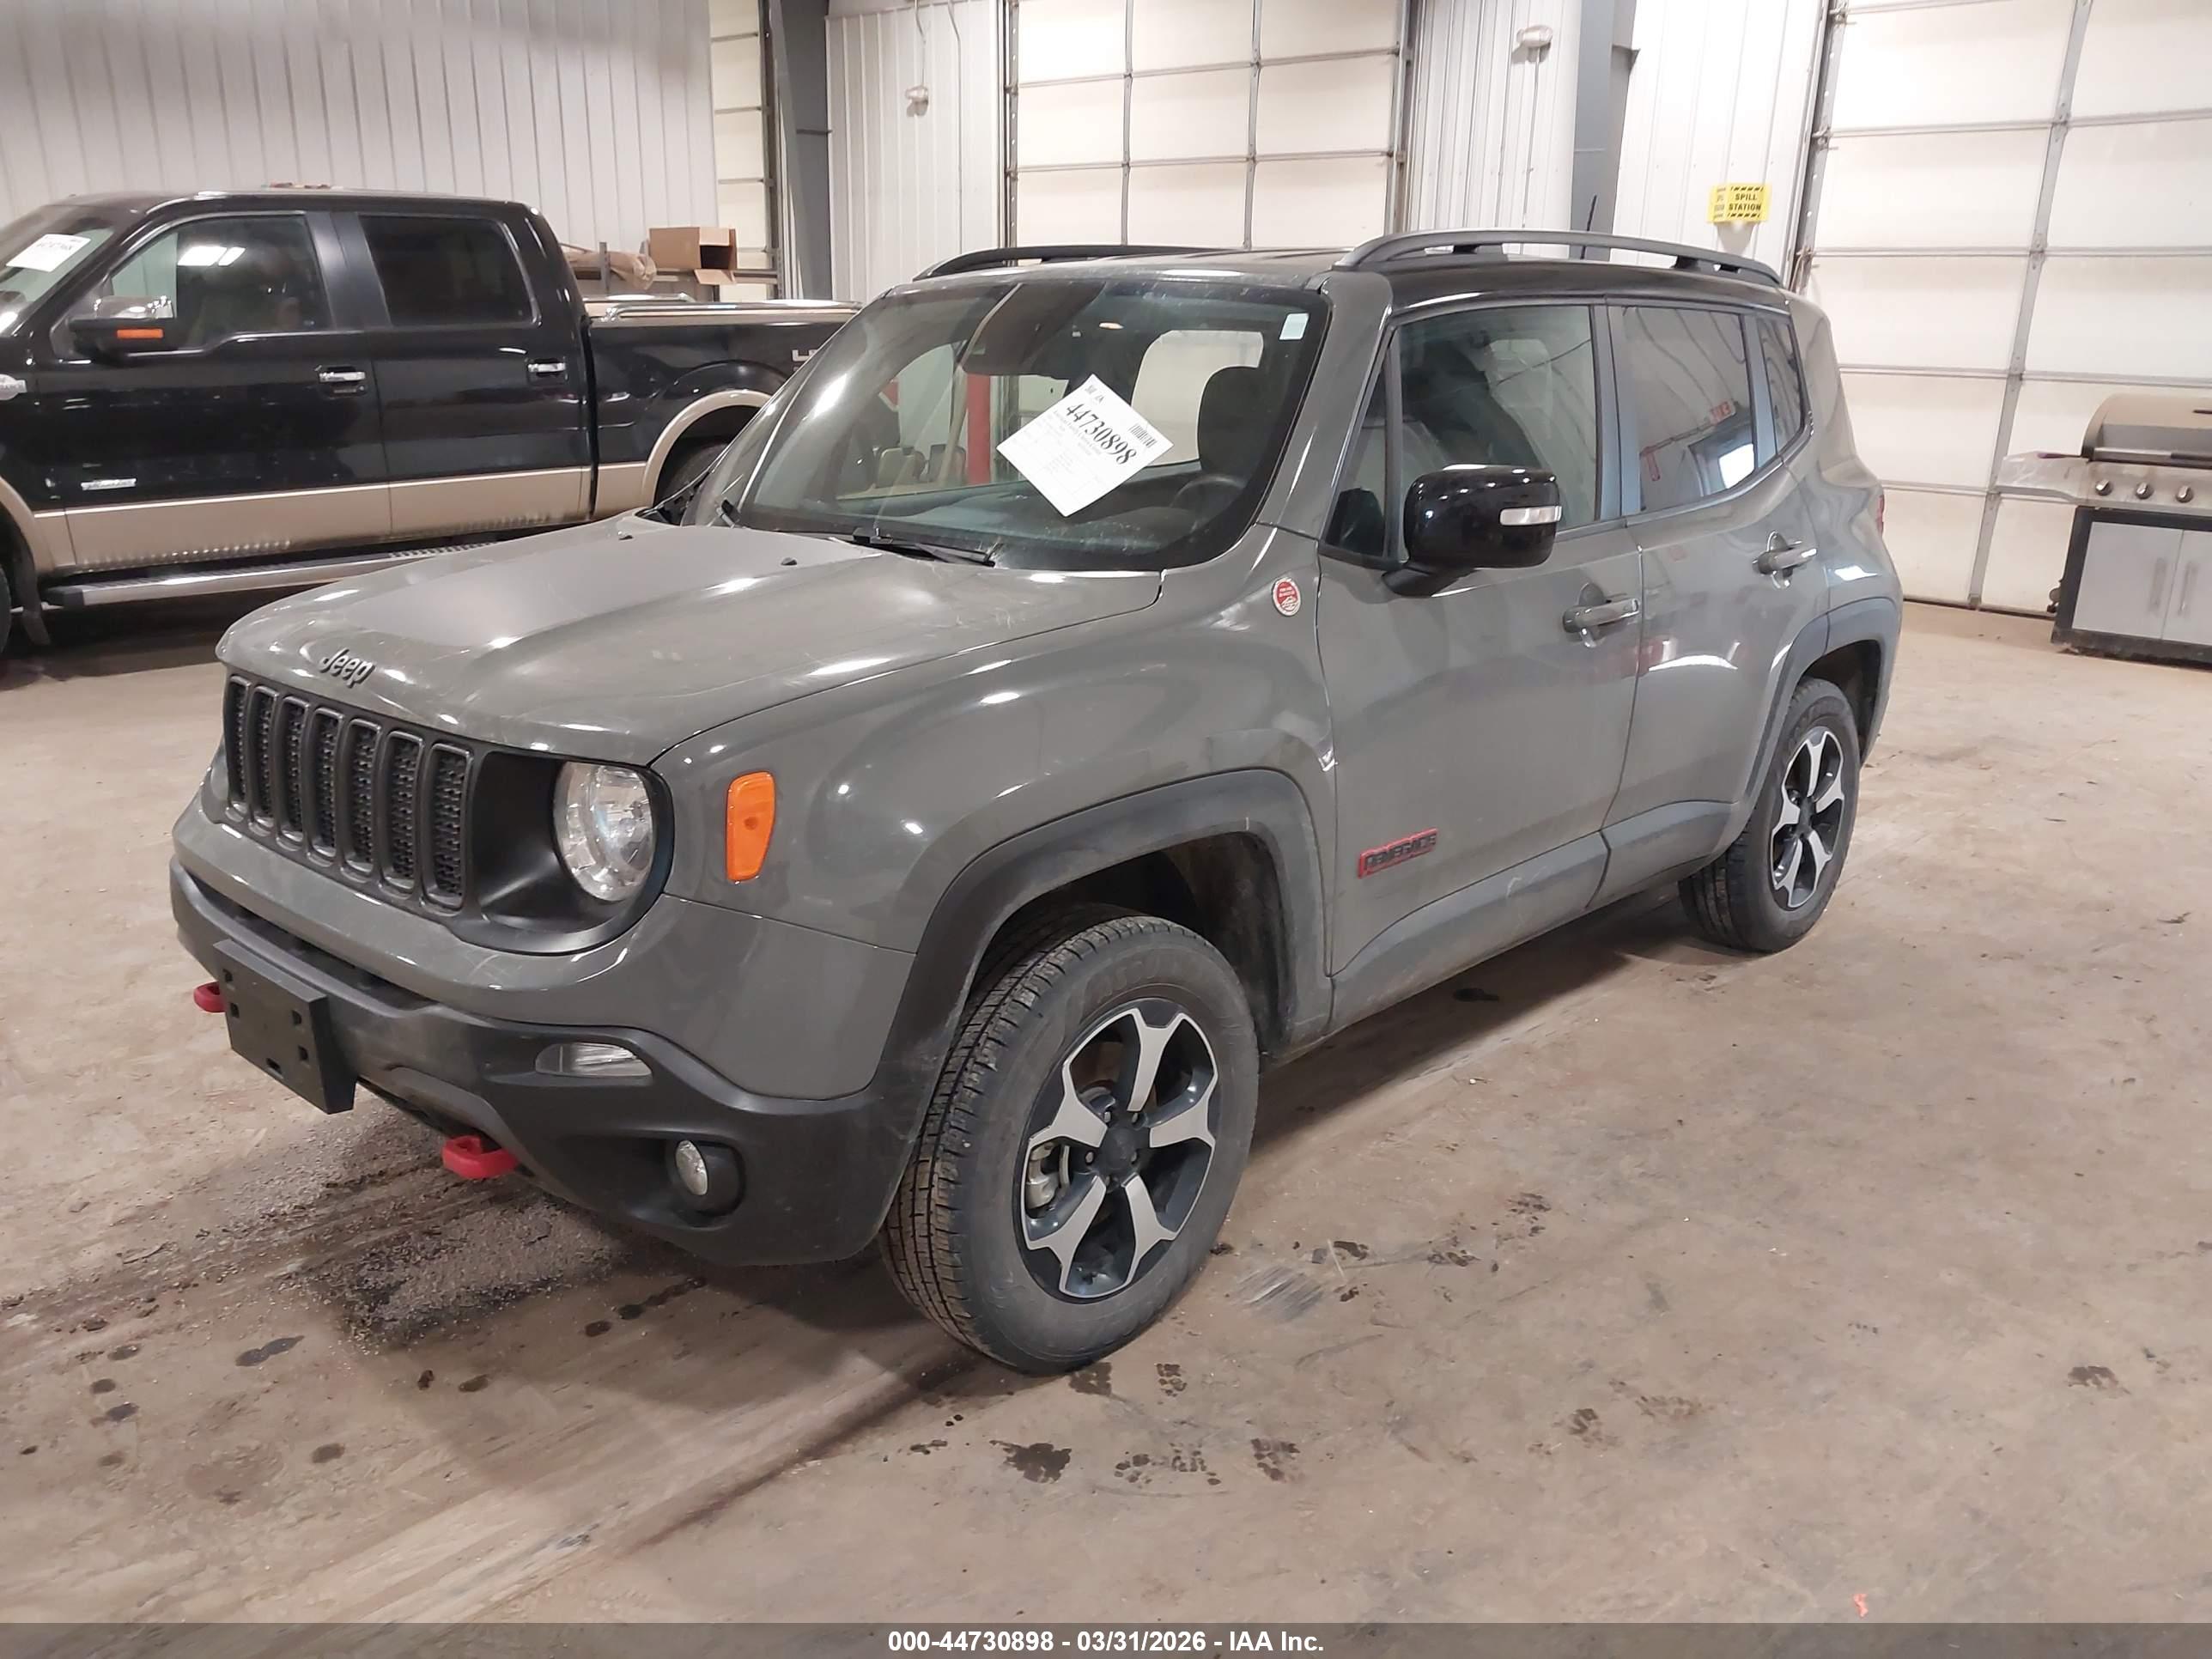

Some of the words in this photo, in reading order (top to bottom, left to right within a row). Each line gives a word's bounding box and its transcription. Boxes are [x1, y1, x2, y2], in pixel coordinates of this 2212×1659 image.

[1728, 203, 1762, 211] STATION
[1735, 192, 1758, 201] SPILL
[1065, 403, 1138, 465] 44730898
[319, 647, 376, 689] Jeep
